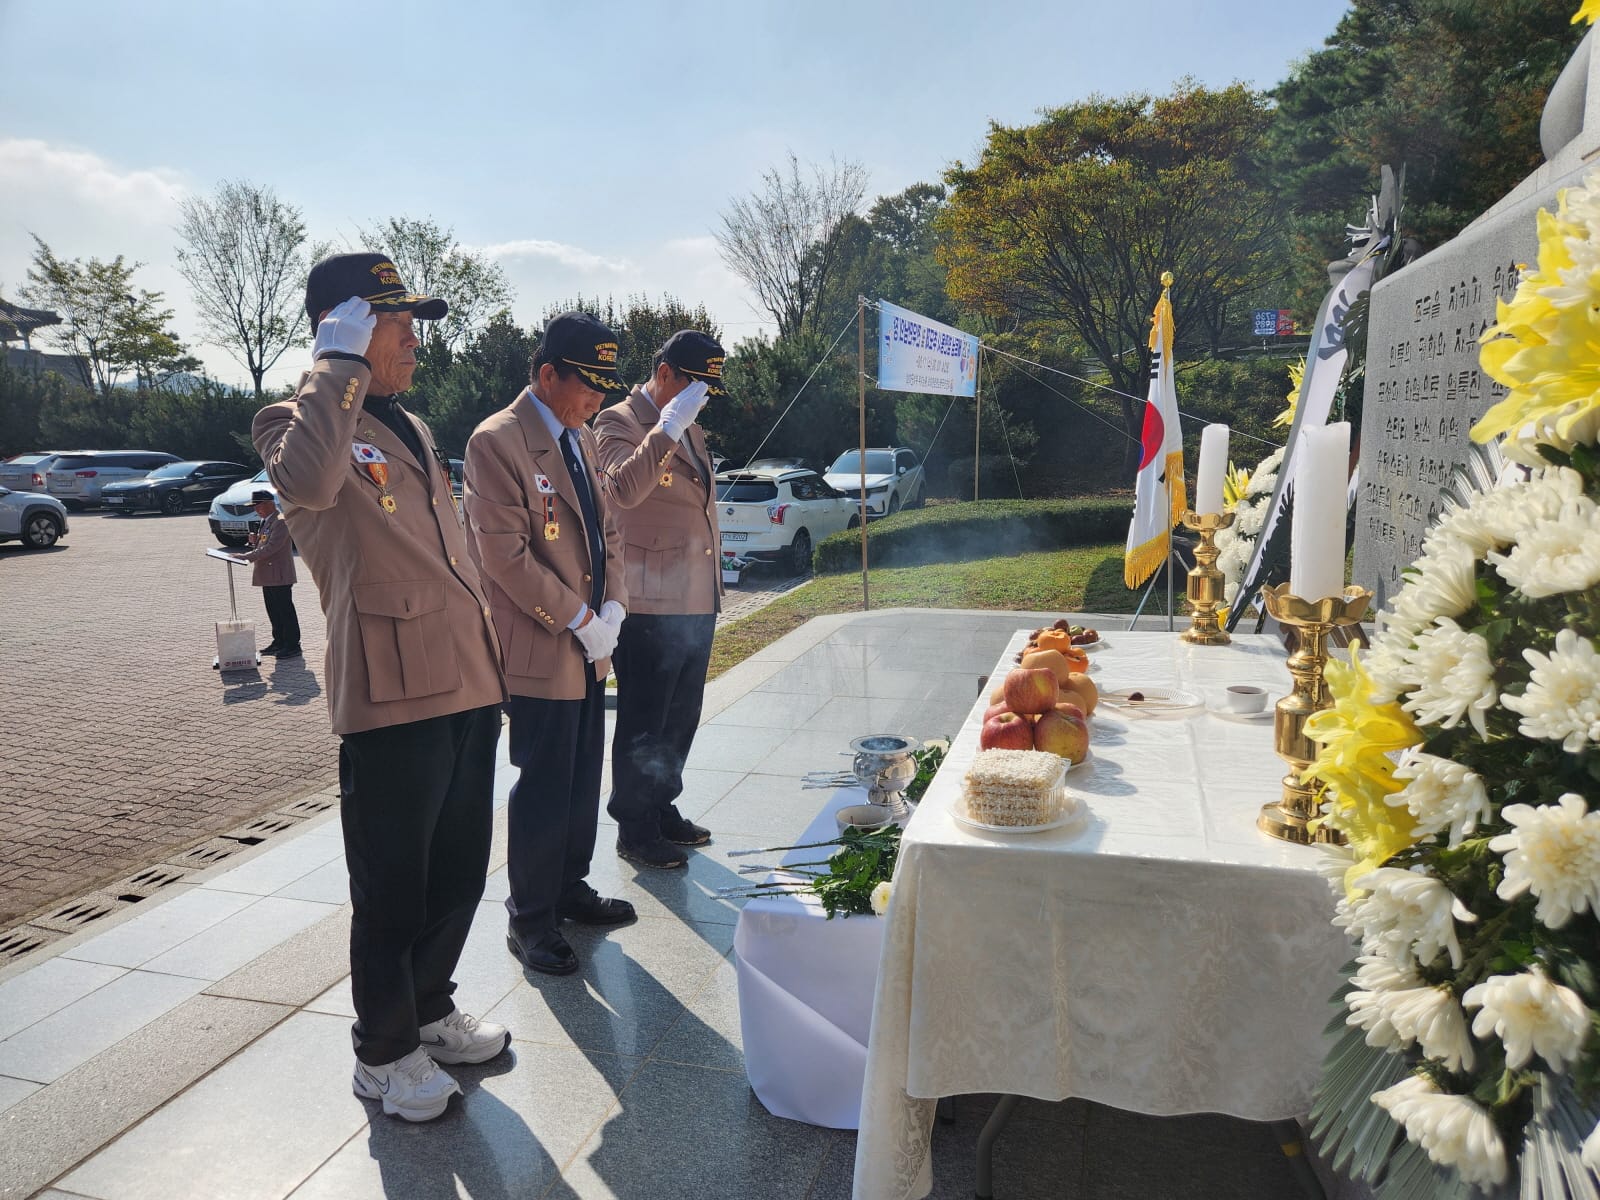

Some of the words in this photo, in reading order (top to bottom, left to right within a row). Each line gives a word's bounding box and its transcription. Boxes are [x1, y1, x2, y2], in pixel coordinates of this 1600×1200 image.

[1414, 290, 1441, 323] 조국을
[1448, 276, 1481, 312] 지키기
[1389, 339, 1412, 368] 인류의
[1418, 331, 1446, 361] 평화와
[1377, 380, 1399, 404] 포성과
[1405, 374, 1440, 402] 화염으로
[1446, 370, 1481, 401] 얼룩진
[1385, 416, 1407, 440] 수만리
[1398, 491, 1423, 522] 숭고한
